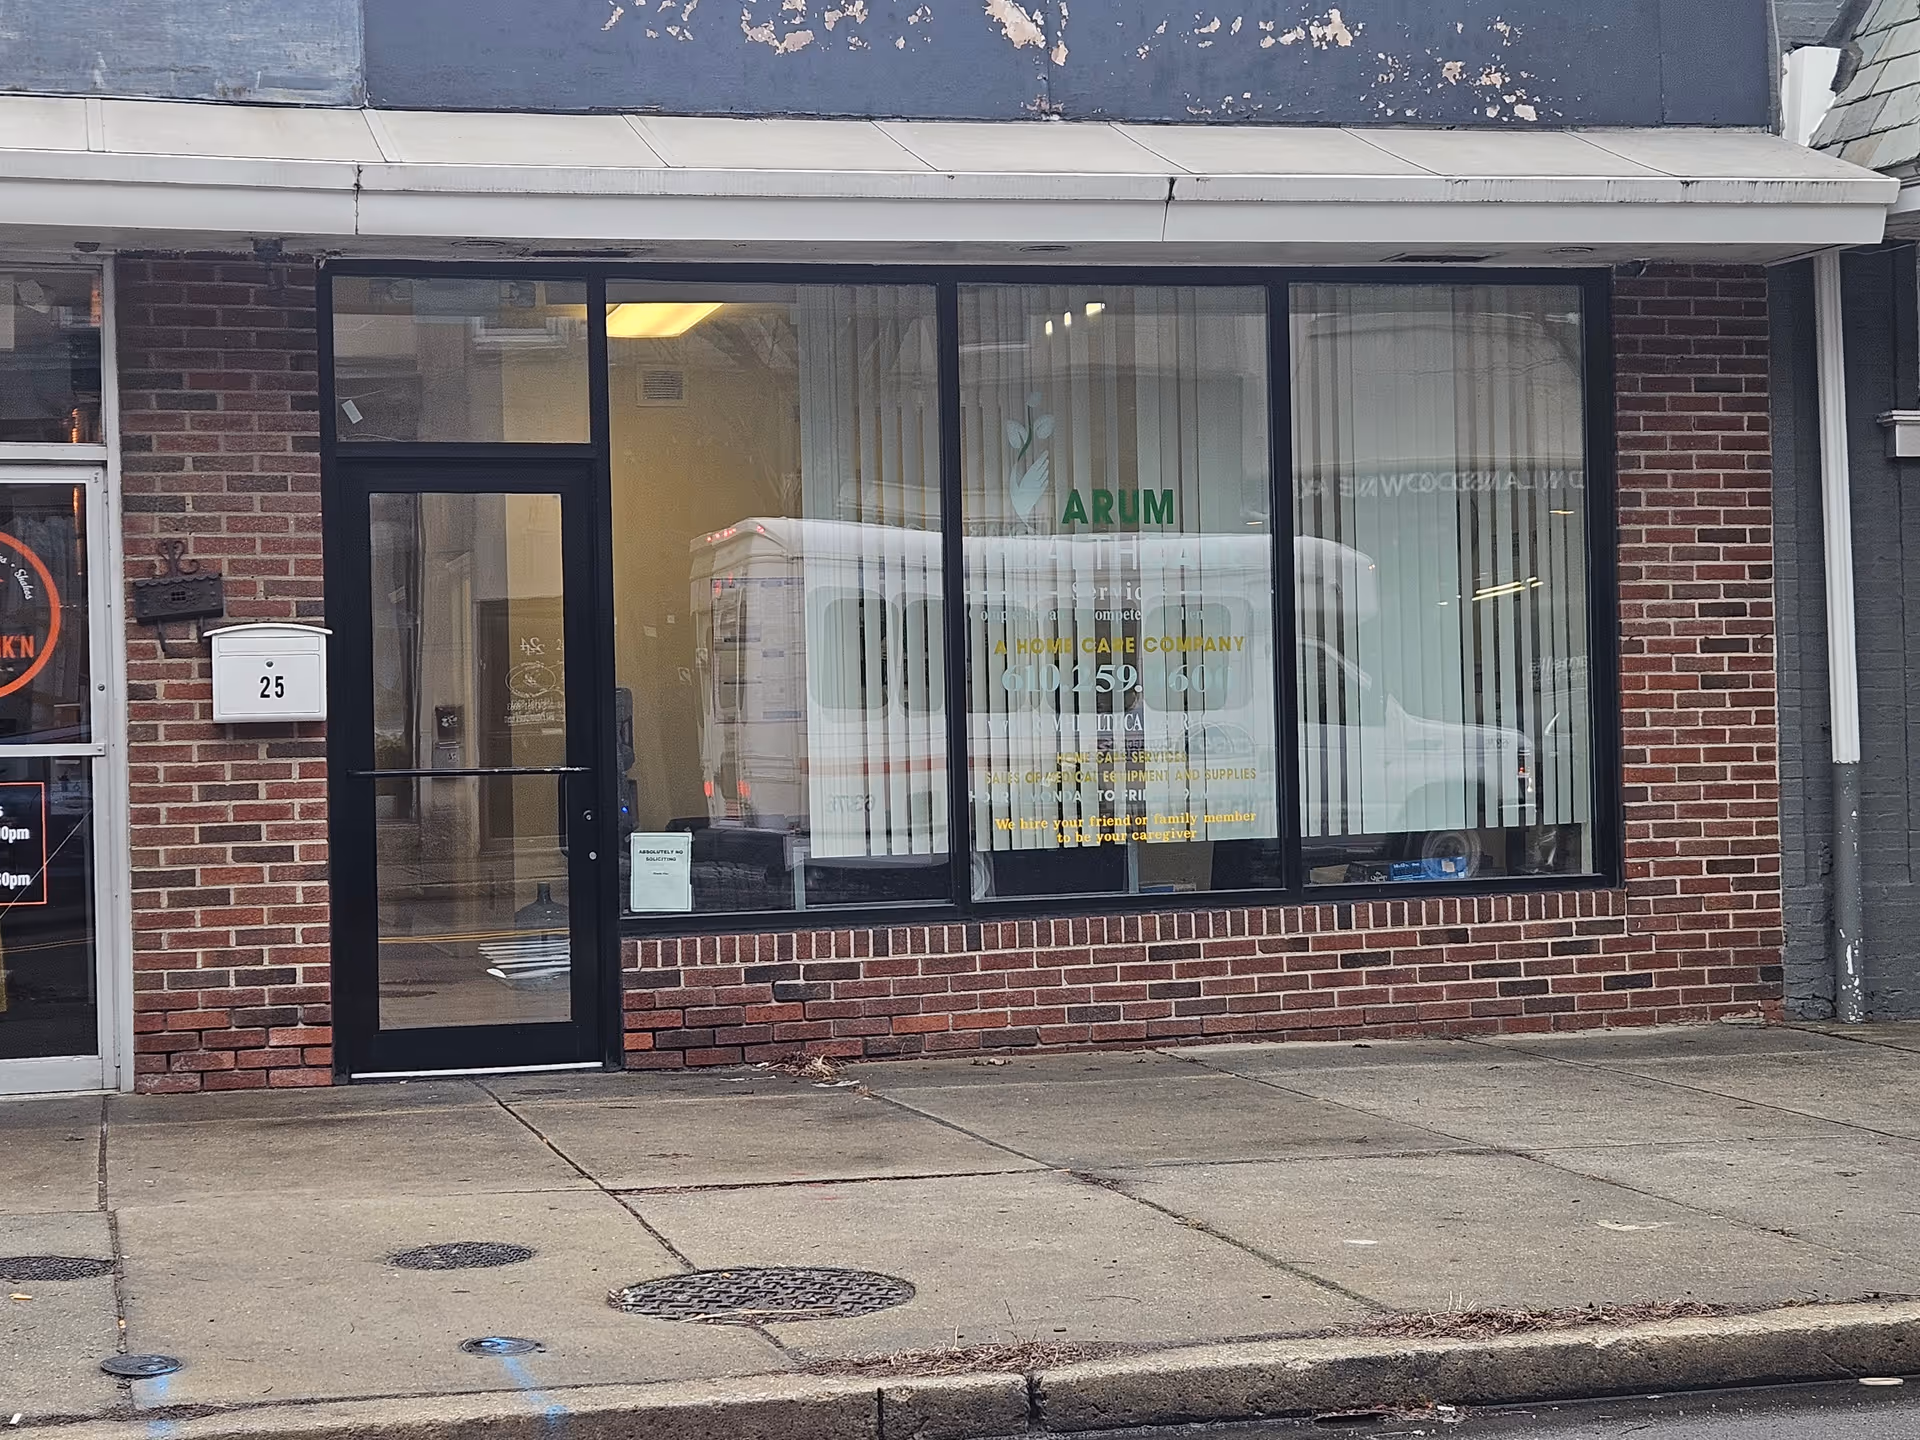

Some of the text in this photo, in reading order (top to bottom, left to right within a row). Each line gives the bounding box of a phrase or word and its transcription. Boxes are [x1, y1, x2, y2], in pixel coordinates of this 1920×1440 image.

[1061, 489, 1174, 525] ARUM
[14, 568, 34, 601] Shakes
[0, 634, 35, 659] K'N
[994, 635, 1245, 655] A HOME CARE COMPANY
[259, 675, 285, 699] 25
[1131, 749, 1188, 764] SERVICES
[984, 772, 1020, 786] SALES
[1175, 767, 1201, 781] AND
[1204, 767, 1257, 781] SUPPLIES
[1097, 789, 1116, 802] TO
[995, 811, 1257, 831] We hire your friend or family member
[0, 825, 31, 844] 0pm
[1057, 827, 1198, 844] to be your caregiver
[0, 871, 32, 891] 0pm
